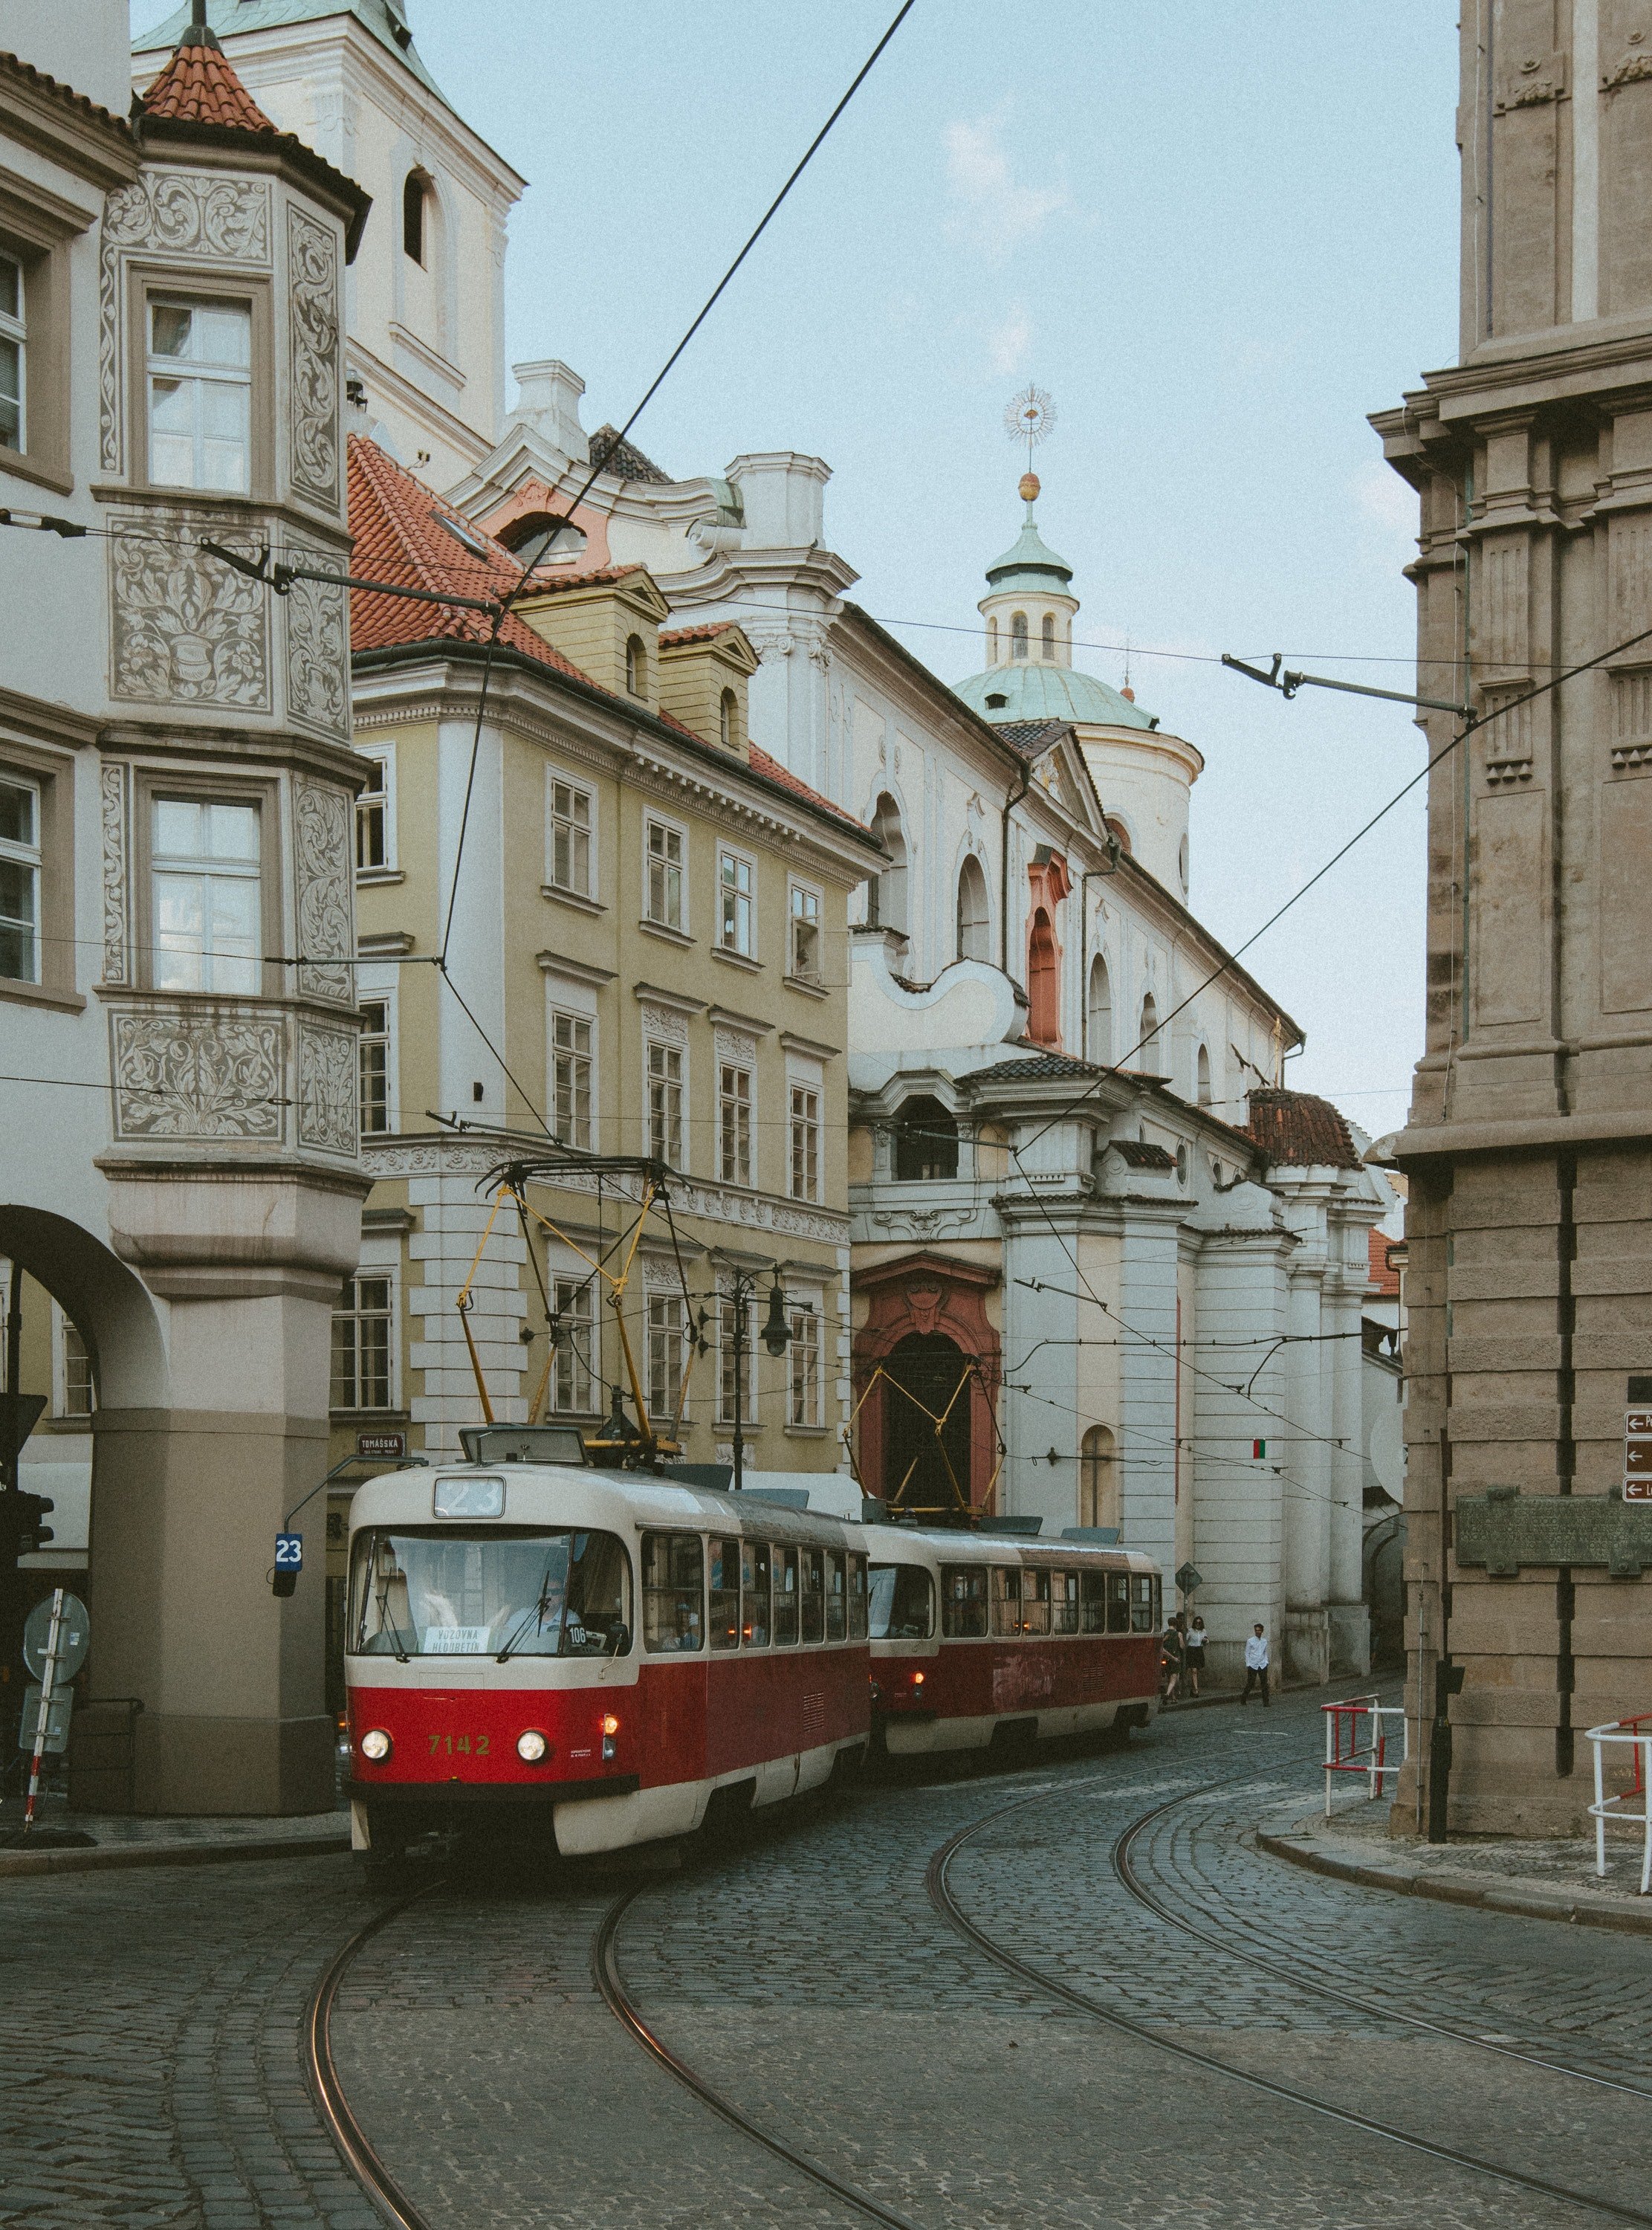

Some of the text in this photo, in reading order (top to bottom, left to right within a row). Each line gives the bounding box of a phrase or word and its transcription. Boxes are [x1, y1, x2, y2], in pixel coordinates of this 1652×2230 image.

[361, 1438, 398, 1448] TOMÁŠSKÁ
[446, 1481, 499, 1513] 23
[276, 1539, 302, 1562] 23
[438, 1629, 478, 1640] VOZOVNA
[569, 1626, 586, 1644] 106
[428, 1735, 490, 1754] 7142
